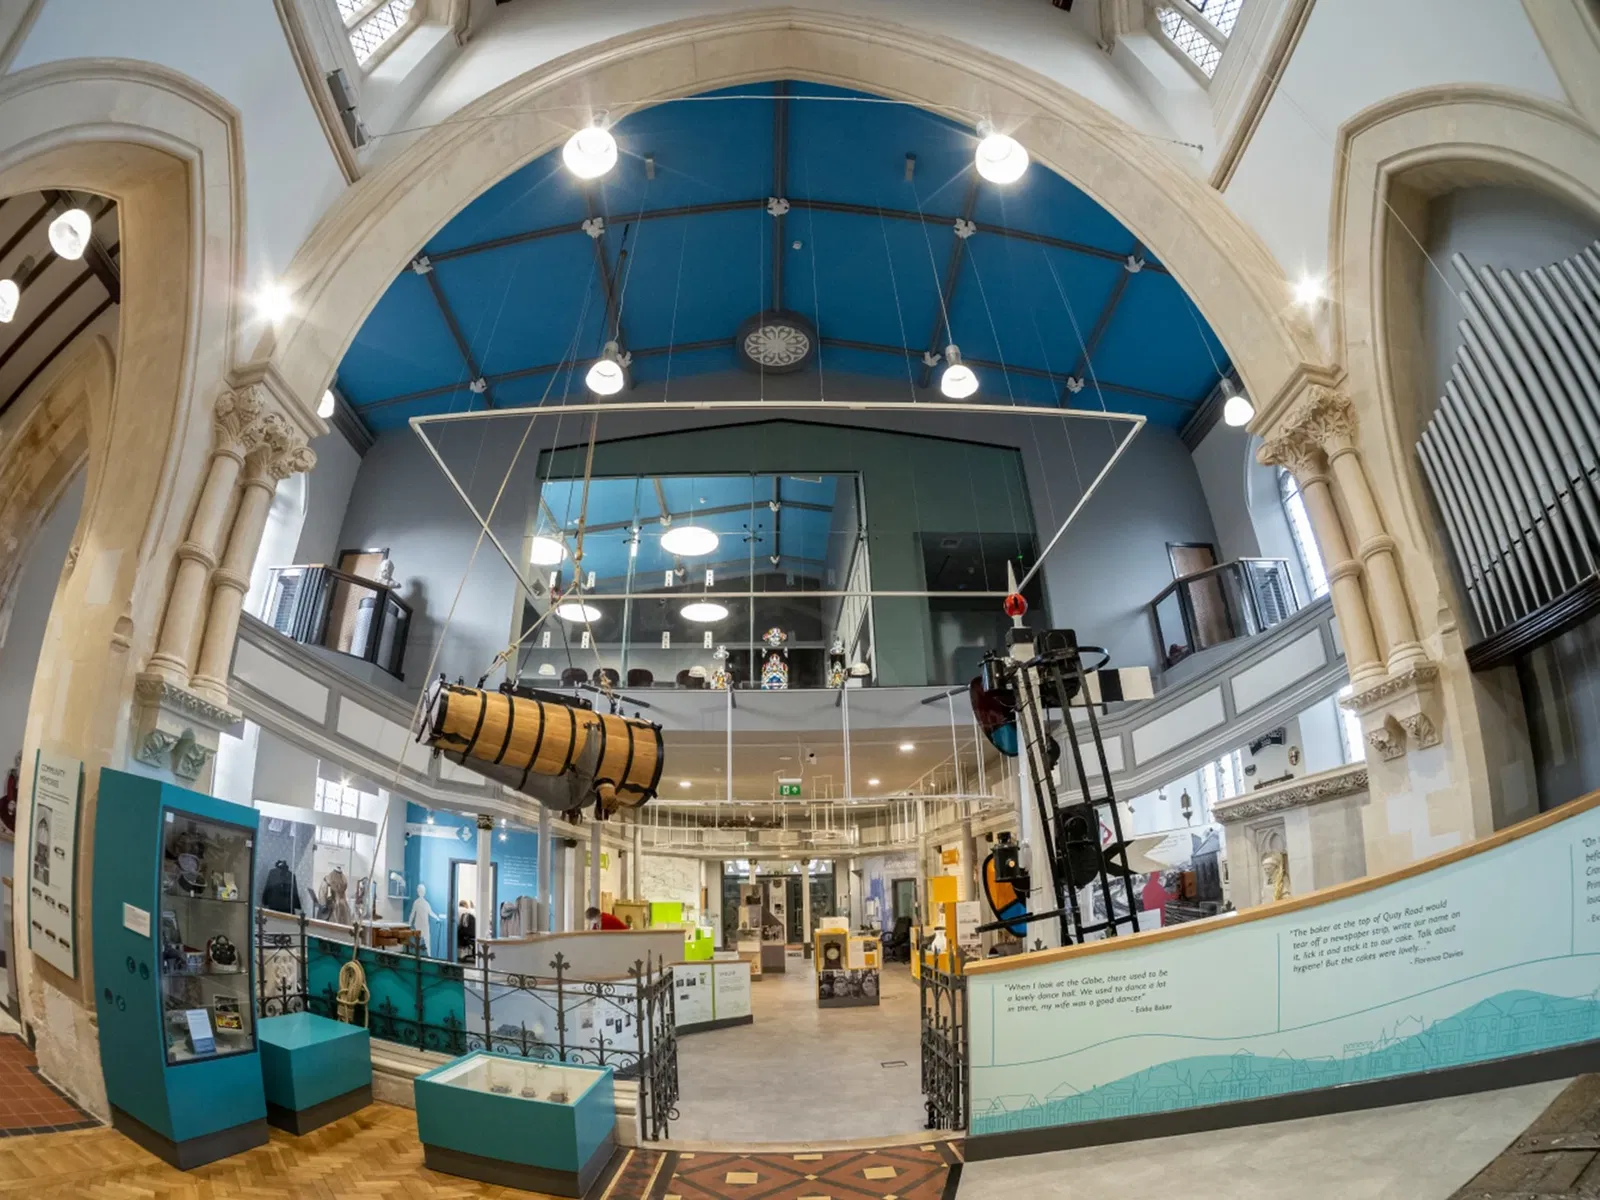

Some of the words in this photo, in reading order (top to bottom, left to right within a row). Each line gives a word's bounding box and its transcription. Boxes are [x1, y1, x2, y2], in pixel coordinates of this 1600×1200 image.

[1310, 925, 1330, 934] baker
[1343, 920, 1355, 929] the
[1358, 917, 1371, 926] top
[1373, 913, 1381, 923] of
[1383, 911, 1402, 922] Quay
[1404, 905, 1423, 916] Road
[1425, 899, 1447, 911] would
[1293, 941, 1308, 950] tear
[1310, 936, 1321, 947] off
[1330, 930, 1369, 942] newspaper
[1393, 922, 1411, 931] write
[1413, 919, 1426, 927] our
[1428, 914, 1448, 924] name
[1451, 911, 1460, 919] on
[1303, 951, 1315, 959] lick
[1327, 946, 1341, 955] and
[1343, 943, 1360, 952] stick
[1380, 938, 1393, 946] our
[1418, 929, 1432, 938] Talk
[1435, 924, 1456, 935] about
[1326, 959, 1339, 967] But
[1341, 956, 1353, 964] the
[1356, 953, 1376, 962] cakes
[1379, 950, 1396, 958] were
[1414, 955, 1441, 964] Florence
[1443, 950, 1464, 959] Davies
[1037, 981, 1053, 989] look
[1066, 979, 1079, 987] the
[1107, 975, 1126, 983] there
[1129, 970, 1146, 980] used
[1159, 969, 1168, 977] be
[1015, 993, 1035, 1002] lovely
[1037, 992, 1059, 1000] dance
[1080, 987, 1092, 995] We
[1095, 985, 1112, 994] used
[1125, 983, 1146, 991] dance
[1156, 980, 1166, 988] lot
[1041, 1003, 1052, 1011] my
[1055, 1000, 1070, 1009] wife
[1096, 997, 1114, 1007] good
